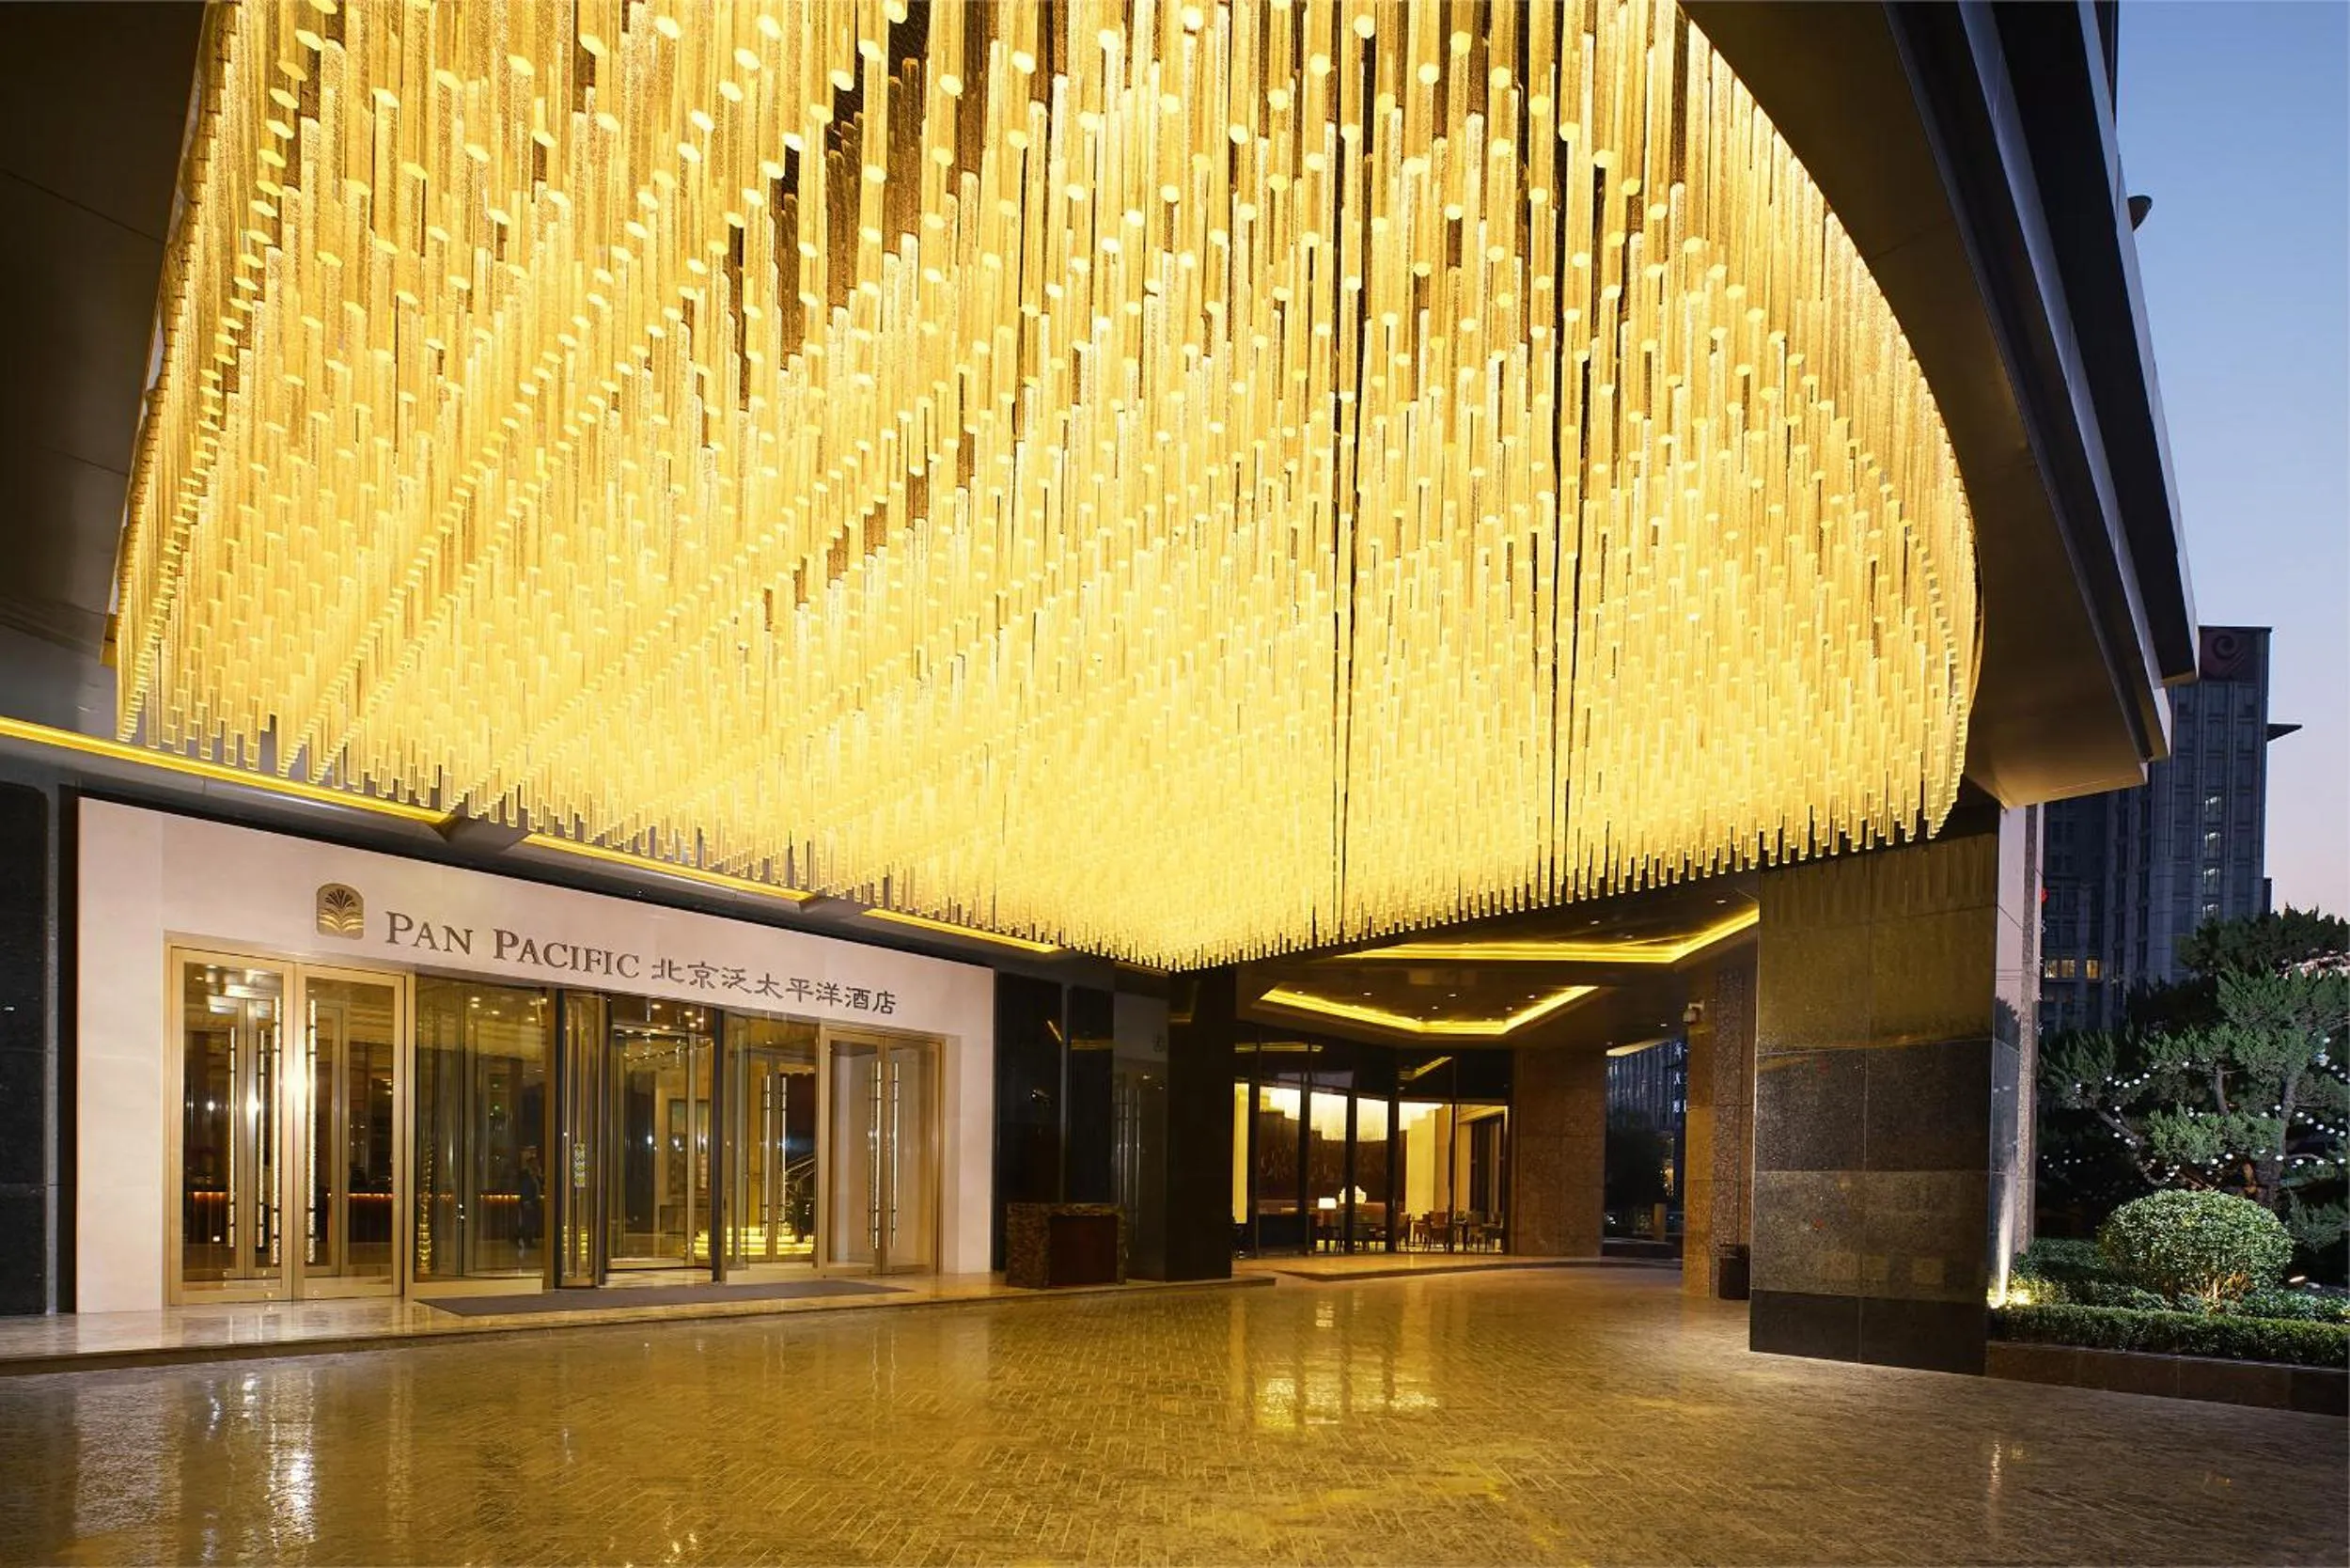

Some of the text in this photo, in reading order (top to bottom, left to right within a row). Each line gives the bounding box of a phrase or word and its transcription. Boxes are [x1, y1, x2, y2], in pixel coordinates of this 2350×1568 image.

[385, 911, 639, 979] PAN PACIFIC
[651, 958, 897, 1014] 北京泛太平洋酒店
